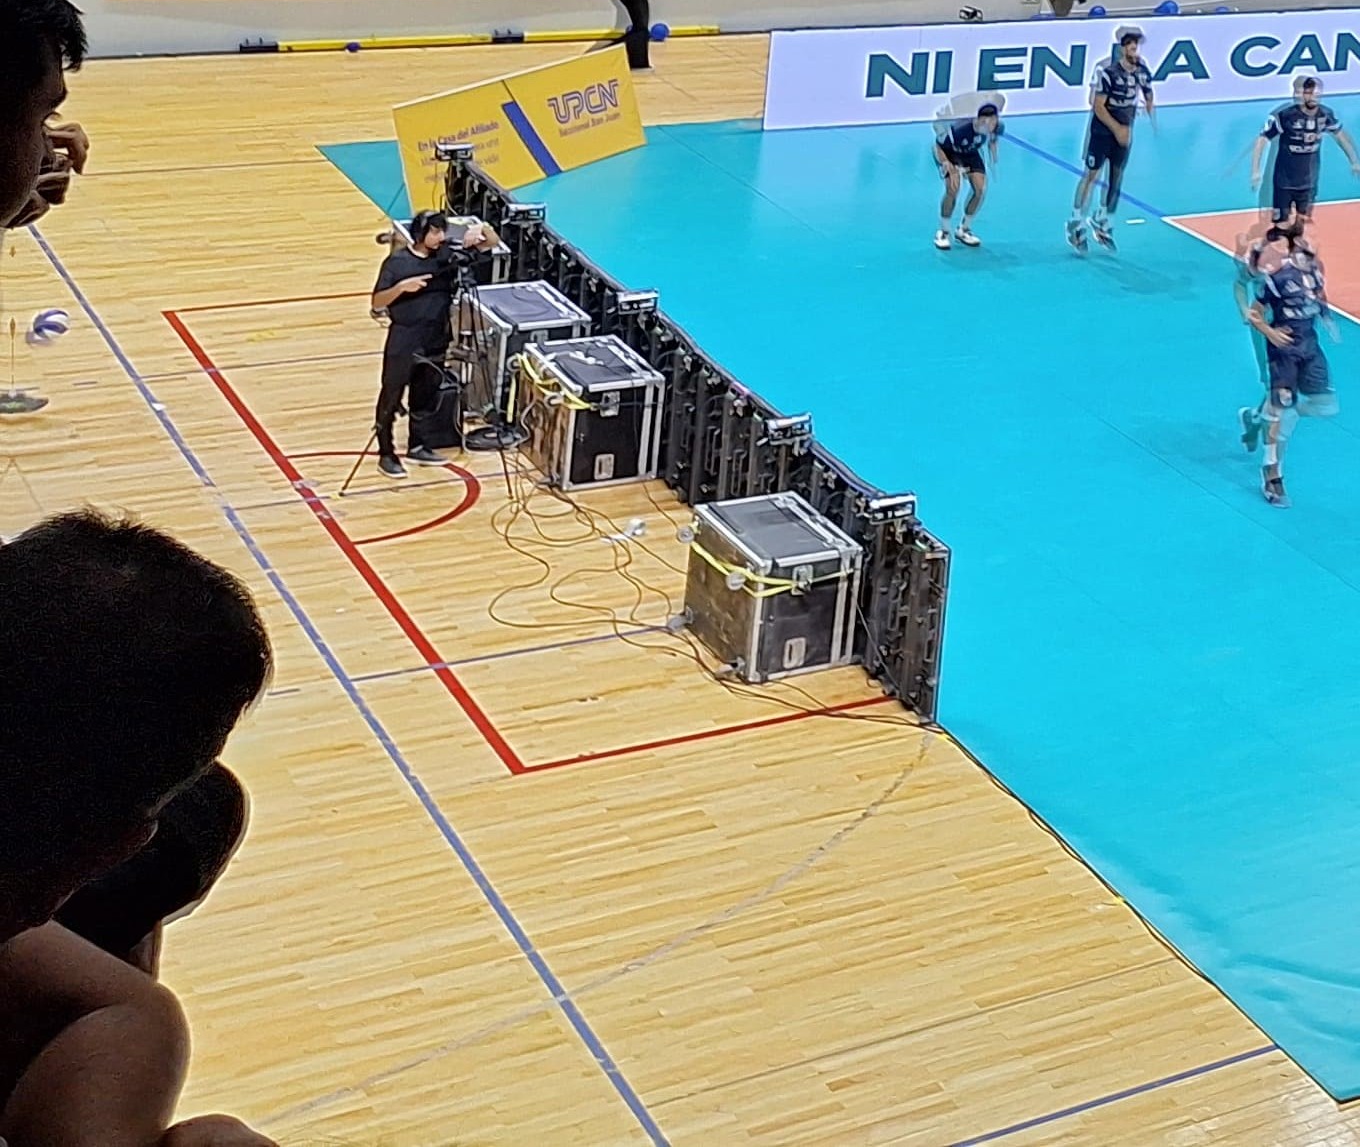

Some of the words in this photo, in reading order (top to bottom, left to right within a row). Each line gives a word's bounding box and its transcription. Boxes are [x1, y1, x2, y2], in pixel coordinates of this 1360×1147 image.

[865, 51, 952, 98] NI
[977, 44, 1088, 90] EN
[547, 78, 619, 124] UPCN
